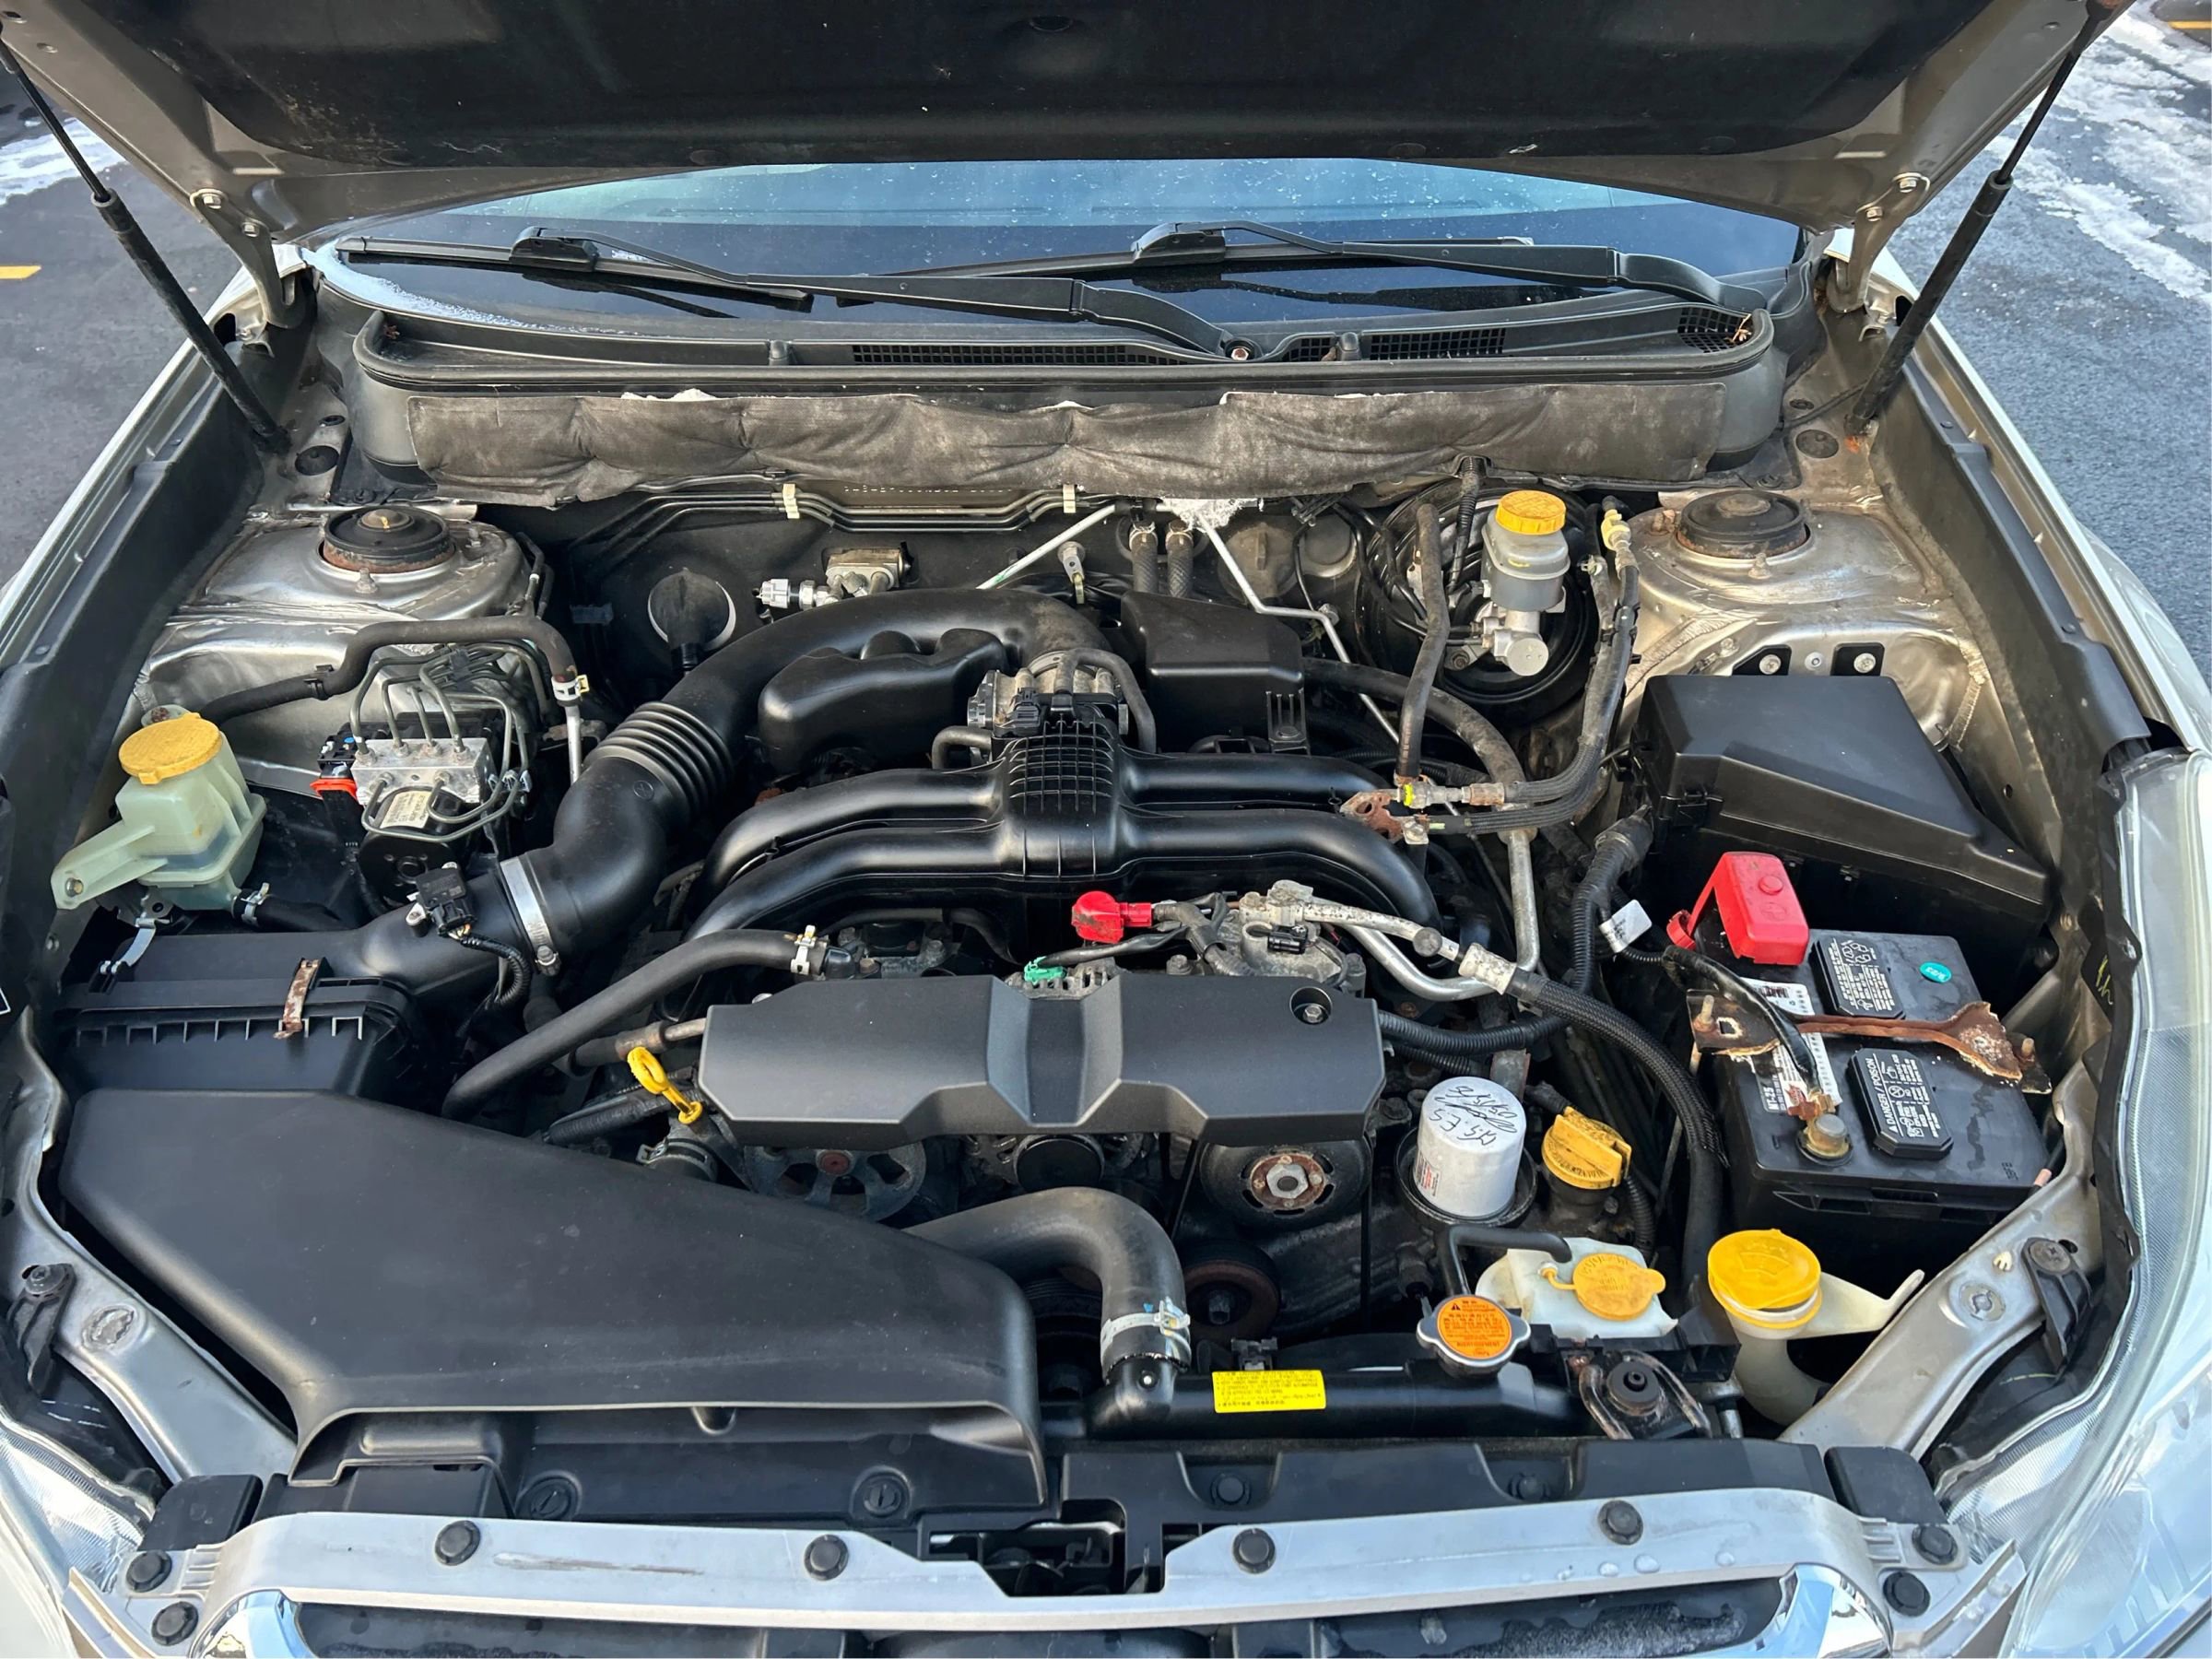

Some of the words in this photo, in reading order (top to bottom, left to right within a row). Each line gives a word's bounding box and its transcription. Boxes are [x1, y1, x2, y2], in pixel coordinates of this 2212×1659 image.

[1865, 1057, 1882, 1087] POISON
[1763, 1087, 1780, 1111] MT-25
[1877, 1093, 1896, 1124] DANGER
